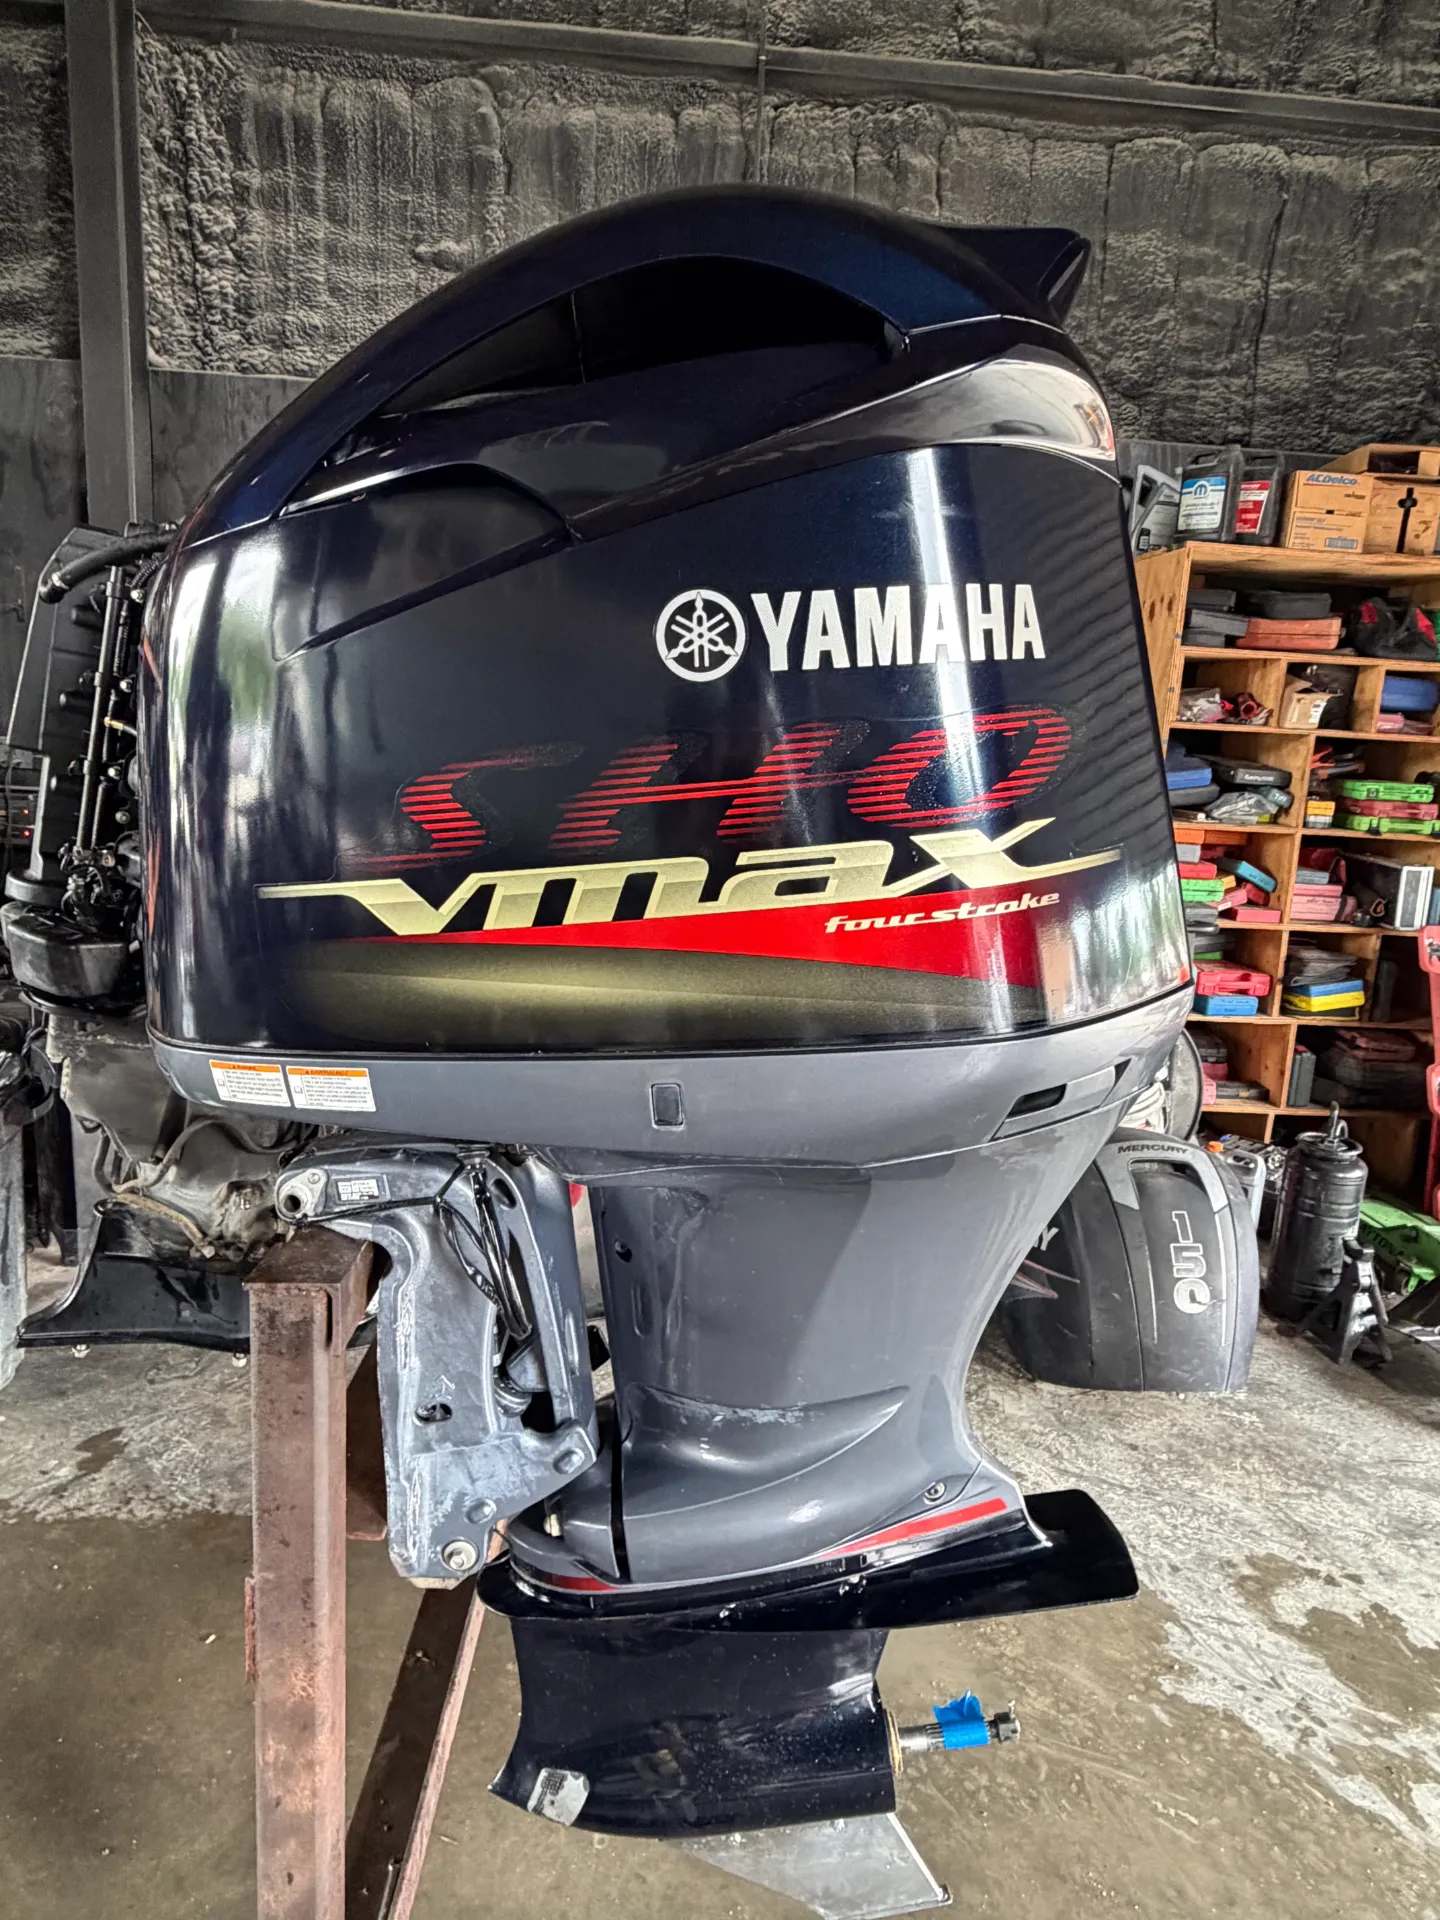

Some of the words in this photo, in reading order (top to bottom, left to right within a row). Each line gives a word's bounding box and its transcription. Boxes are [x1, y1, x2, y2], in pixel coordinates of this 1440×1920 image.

[1306, 473, 1358, 486] ACDelco
[750, 583, 1046, 672] YAMAHA
[1117, 1143, 1189, 1155] MERCURY
[1169, 1210, 1211, 1315] 150
